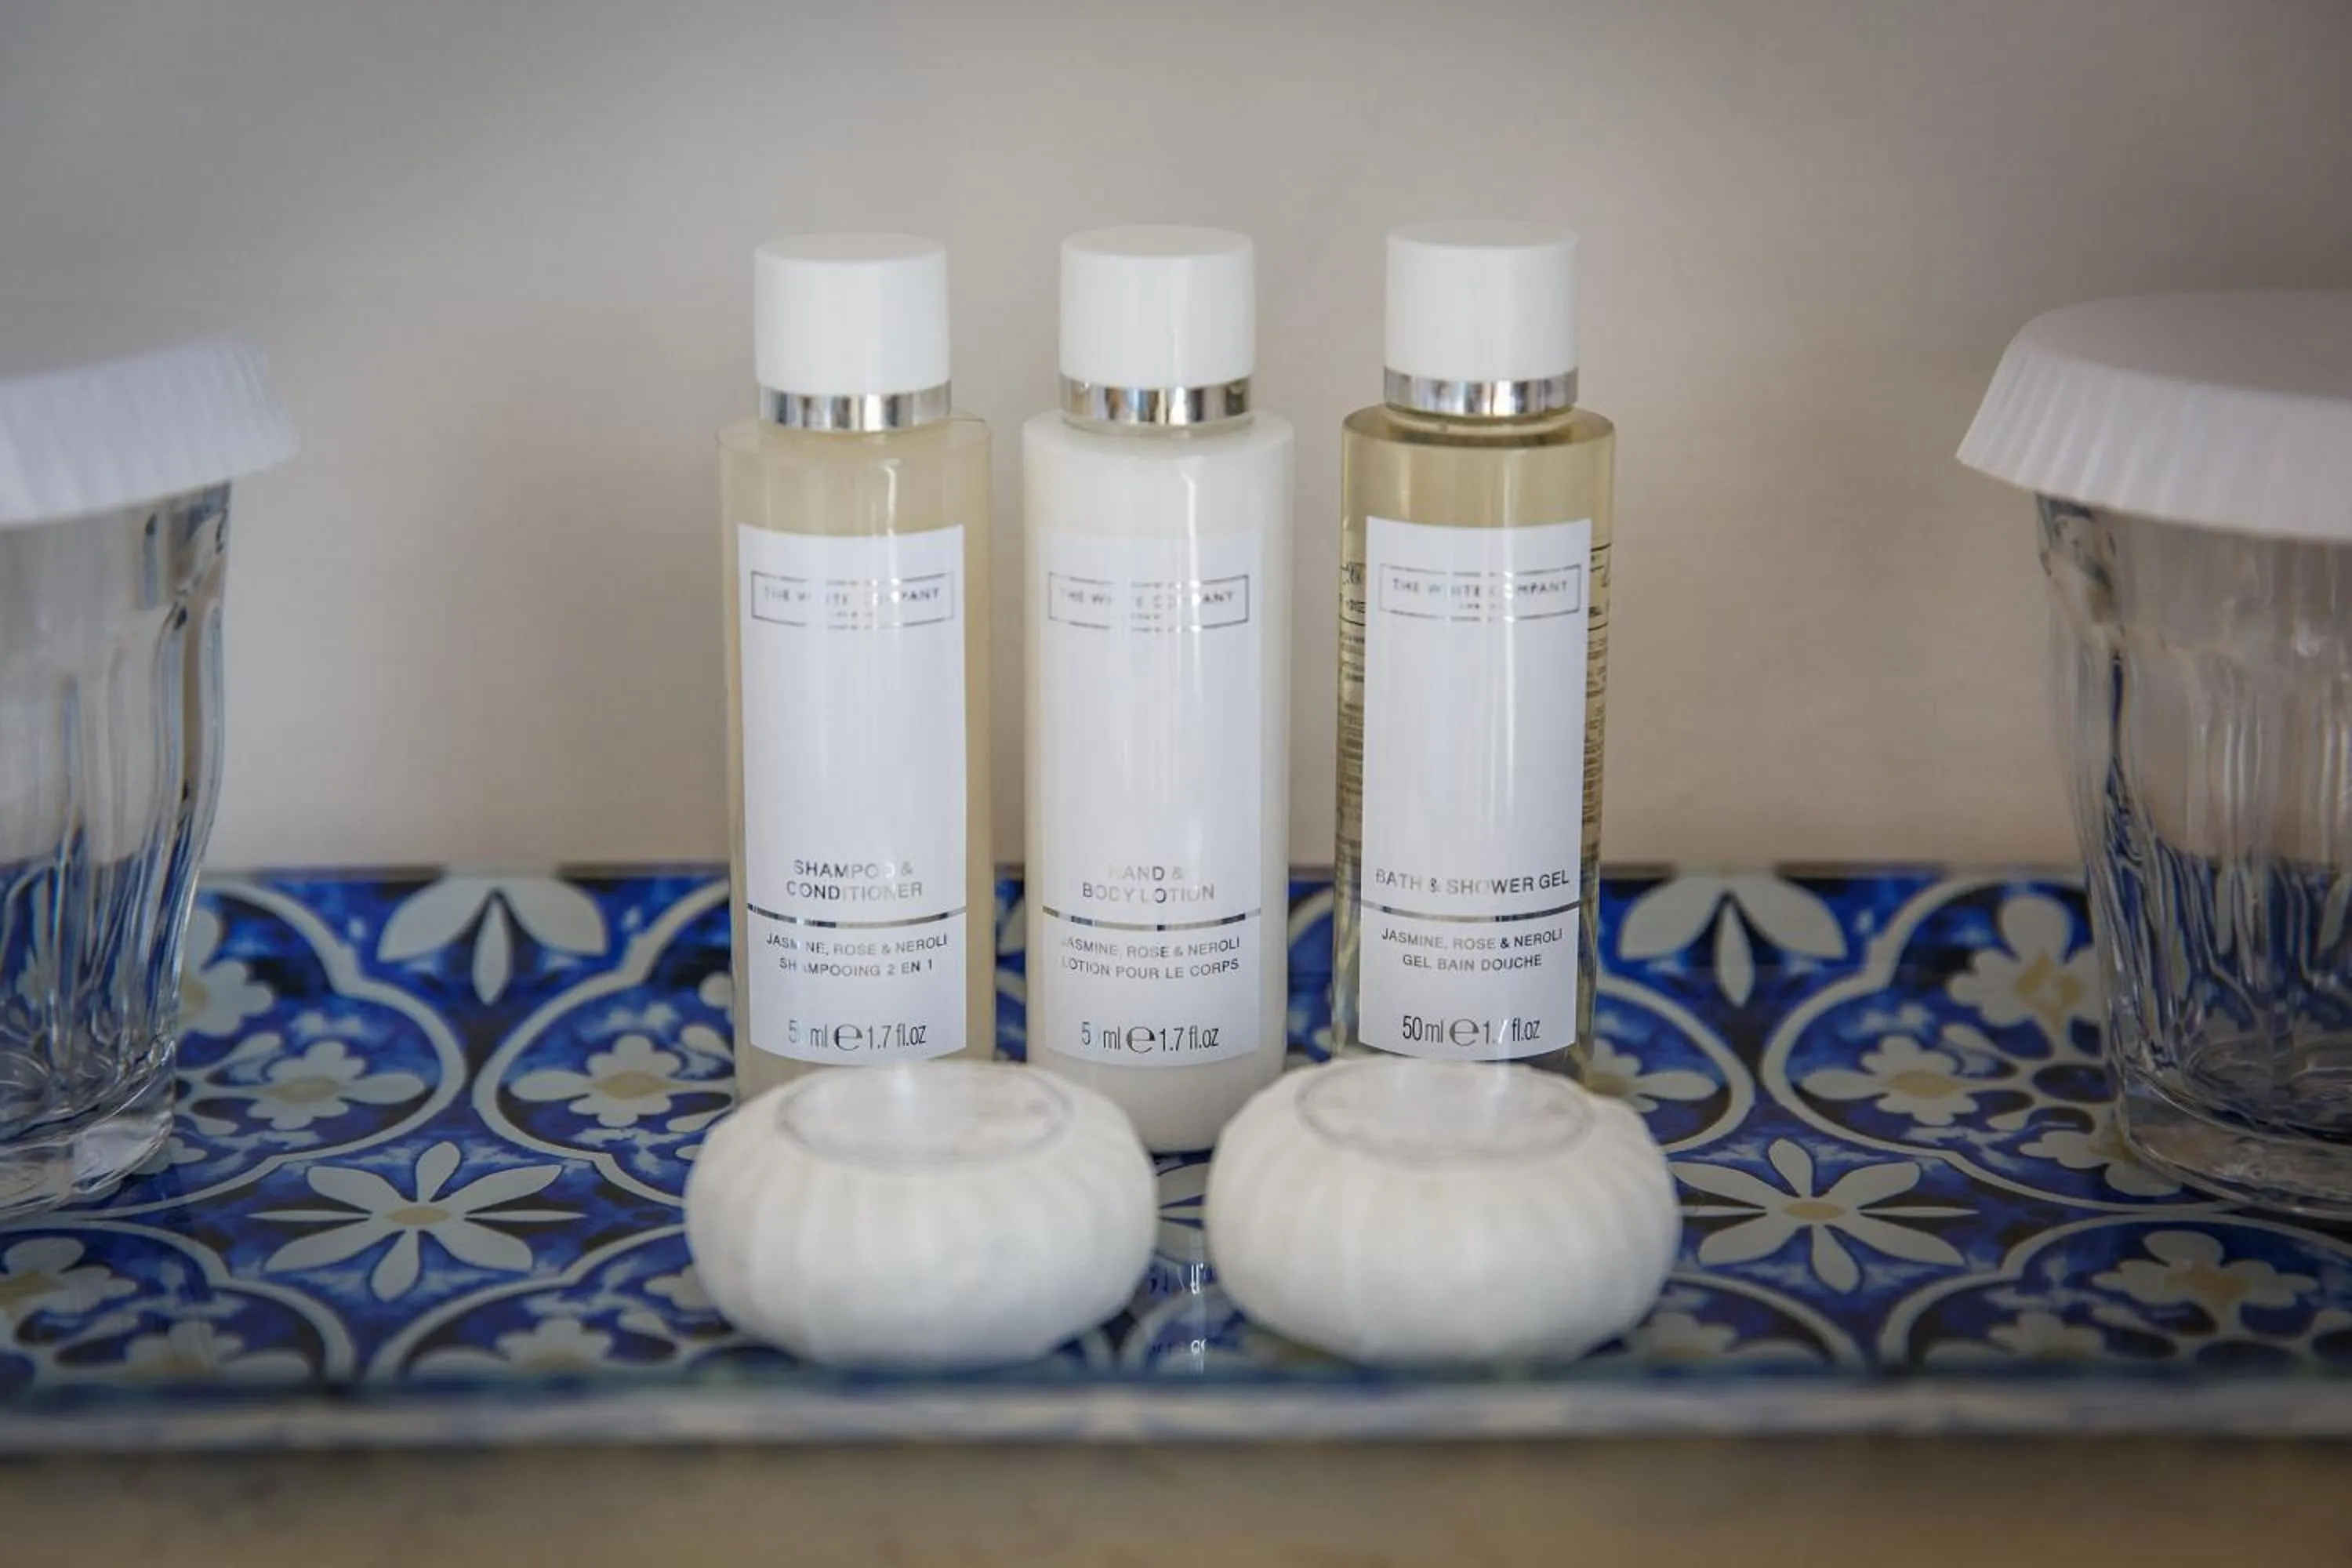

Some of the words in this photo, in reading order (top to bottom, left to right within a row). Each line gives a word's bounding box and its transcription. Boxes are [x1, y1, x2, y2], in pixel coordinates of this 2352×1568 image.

[1489, 580, 1567, 597] CMPANY
[900, 861, 913, 877] &
[1109, 864, 1166, 881] HAND
[1171, 866, 1184, 880] &
[786, 880, 922, 902] CONDITIONER
[1375, 868, 1422, 891] BATH
[1429, 877, 1442, 893] &
[1446, 876, 1534, 895] SHOWER
[1539, 869, 1570, 889] GEL
[1082, 882, 1137, 902] BODY
[1141, 883, 1214, 904] LOTION
[766, 932, 829, 956] JASMNE,
[833, 942, 877, 956] ROSE
[881, 942, 891, 953] &
[895, 933, 947, 953] NEROLI
[1127, 946, 1170, 959] ROSE
[1175, 946, 1184, 957] &
[1188, 937, 1240, 956] NEROLI
[1381, 928, 1448, 950] JASMINE,
[1453, 938, 1496, 951] ROSE
[1500, 937, 1509, 949] &
[1514, 928, 1563, 948] NEROLI
[779, 957, 880, 977] SHMPOOING
[887, 964, 895, 975] 2
[902, 961, 920, 974] EN
[927, 958, 933, 970] 1
[1062, 956, 1110, 977] LOTION
[1116, 966, 1160, 979] POUR
[1166, 966, 1184, 979] LE
[1190, 957, 1240, 978] CORPS
[1403, 954, 1431, 968] GEL
[1438, 957, 1475, 971] BAIN
[1481, 954, 1542, 971] DOUCHE
[788, 1019, 828, 1048] 5ml
[1081, 1021, 1120, 1051] 5ml
